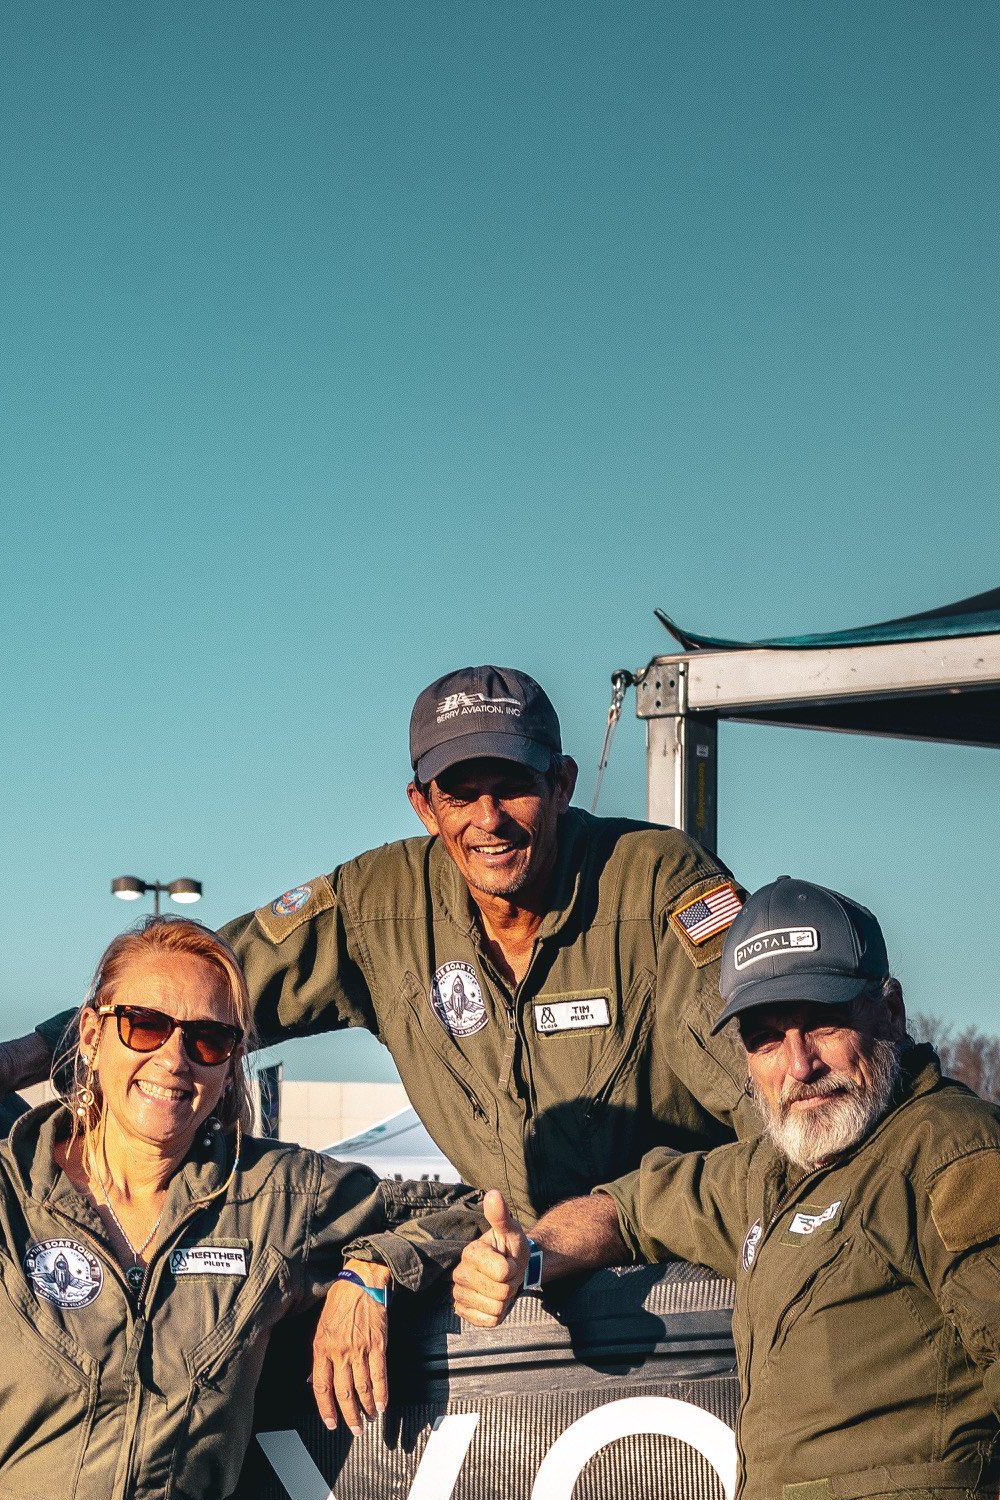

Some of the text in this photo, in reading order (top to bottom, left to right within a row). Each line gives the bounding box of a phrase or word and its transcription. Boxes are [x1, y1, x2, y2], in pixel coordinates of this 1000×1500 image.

[436, 709, 460, 724] BERRY
[461, 705, 504, 715] AVIATION,
[737, 936, 791, 962] PIVOTAL
[571, 1005, 590, 1014] TIM
[31, 1241, 94, 1261] THE SOAR TOUR
[186, 1251, 244, 1262] HEATHER
